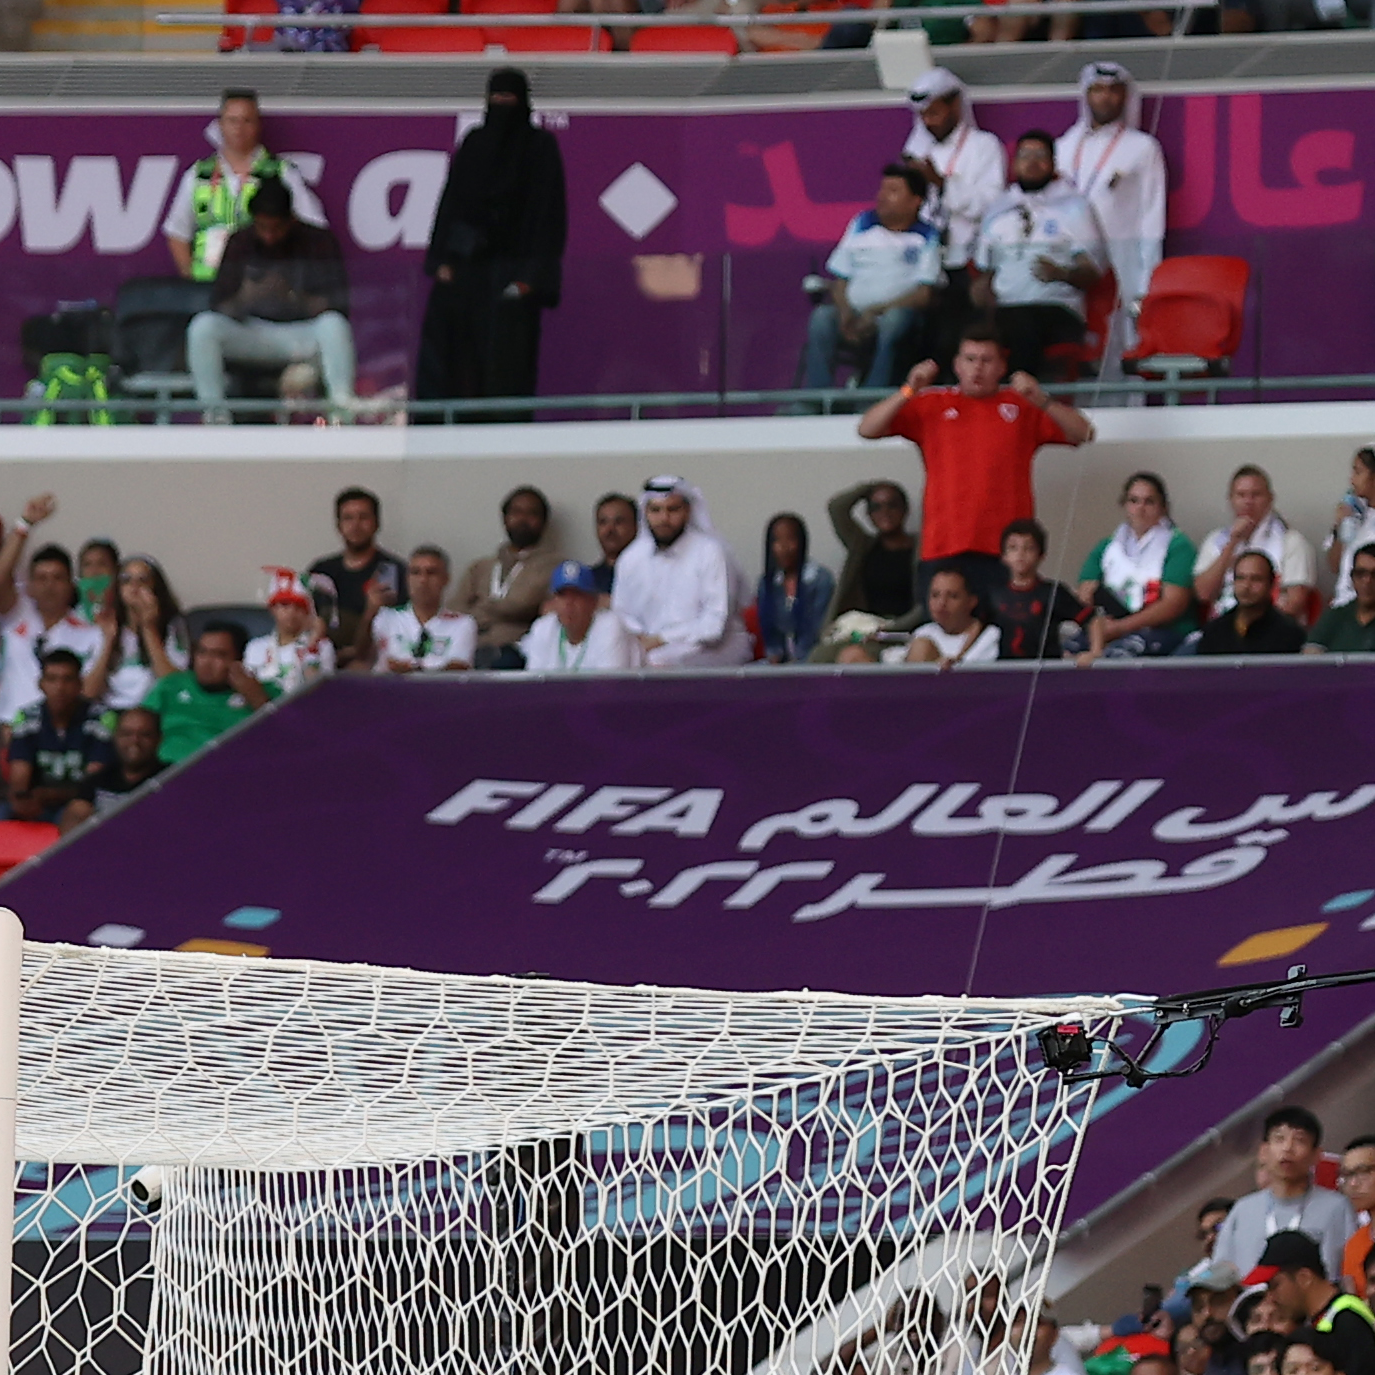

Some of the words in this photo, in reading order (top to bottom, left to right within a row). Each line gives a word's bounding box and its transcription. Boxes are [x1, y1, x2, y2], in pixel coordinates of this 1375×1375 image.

[423, 777, 725, 837] FIFA
[736, 778, 1166, 852] العالم
[790, 827, 1291, 923] قطر
